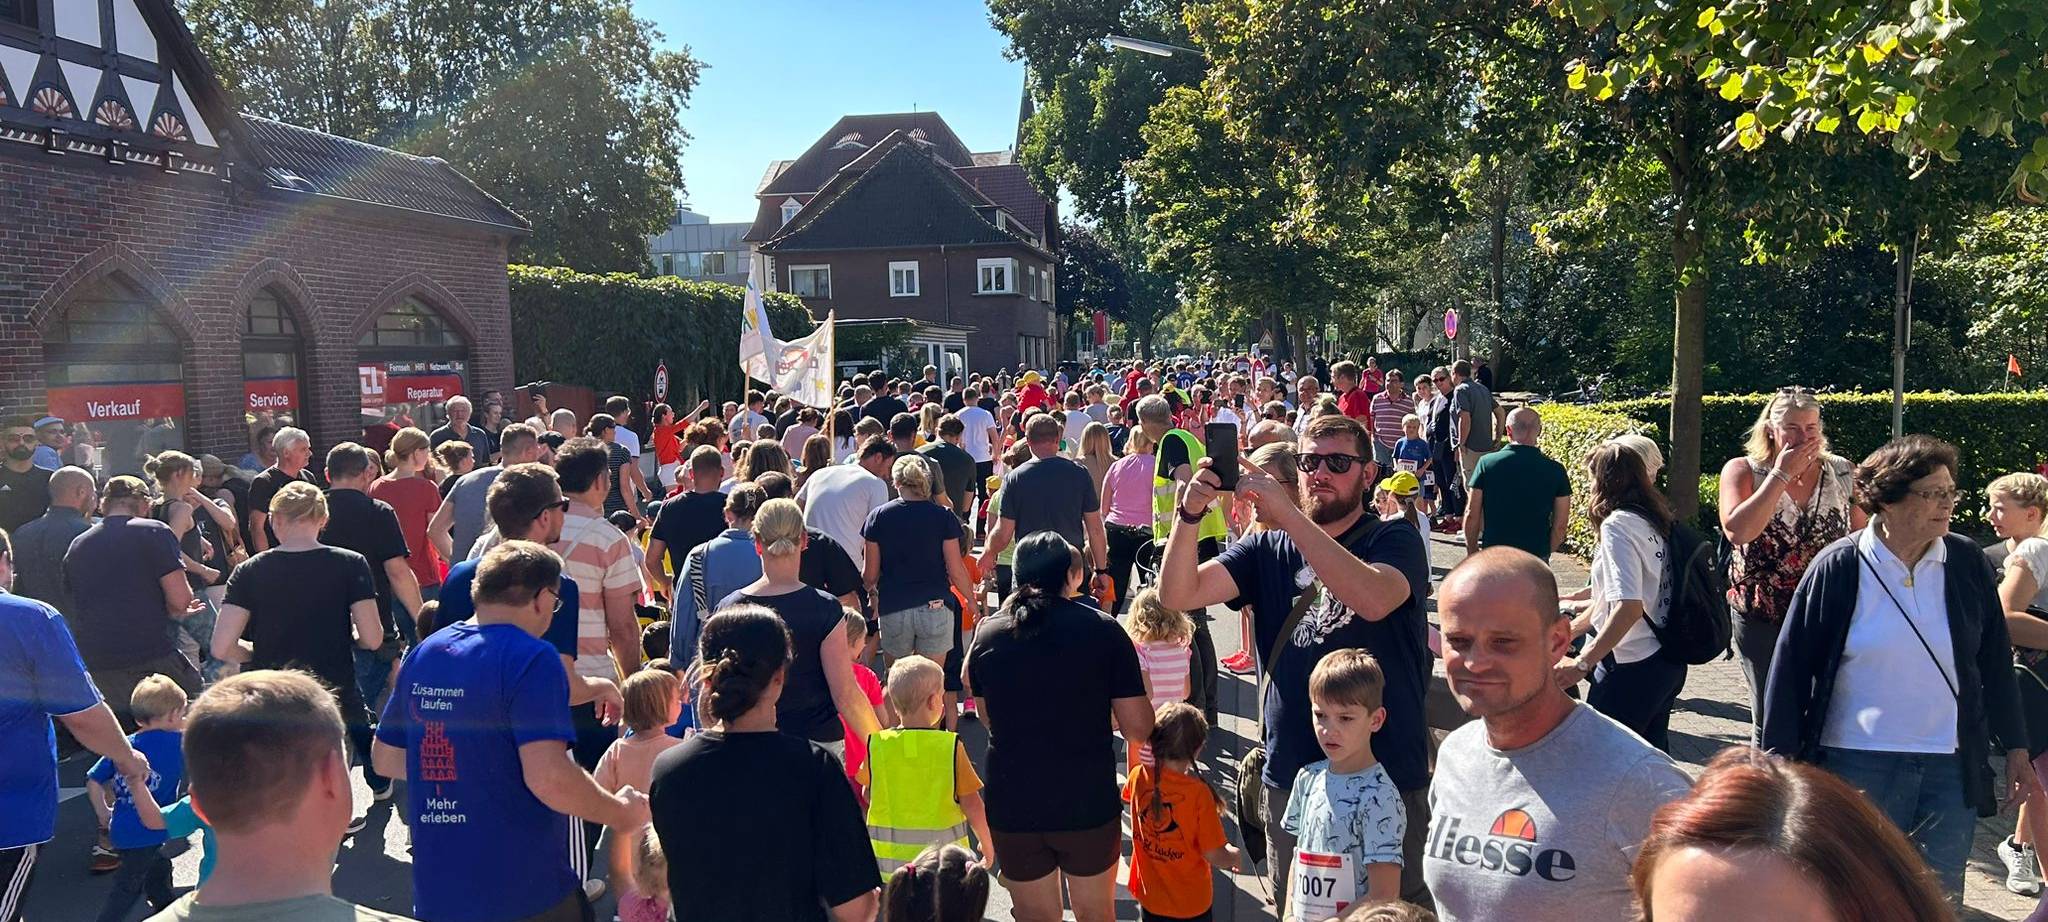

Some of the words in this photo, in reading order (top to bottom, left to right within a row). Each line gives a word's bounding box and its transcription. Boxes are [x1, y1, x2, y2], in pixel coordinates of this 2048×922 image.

[389, 363, 410, 372] Fernseh
[430, 362, 451, 371] Netzwerk
[249, 392, 289, 407] Service
[407, 387, 444, 401] Reparatur
[87, 399, 141, 418] Verkauf
[412, 682, 465, 697] Zusammen
[420, 697, 453, 711] laufen
[426, 798, 457, 810] Mehr
[420, 811, 466, 824] erleben
[1428, 814, 1576, 882] llesse
[1299, 874, 1337, 898] 007
